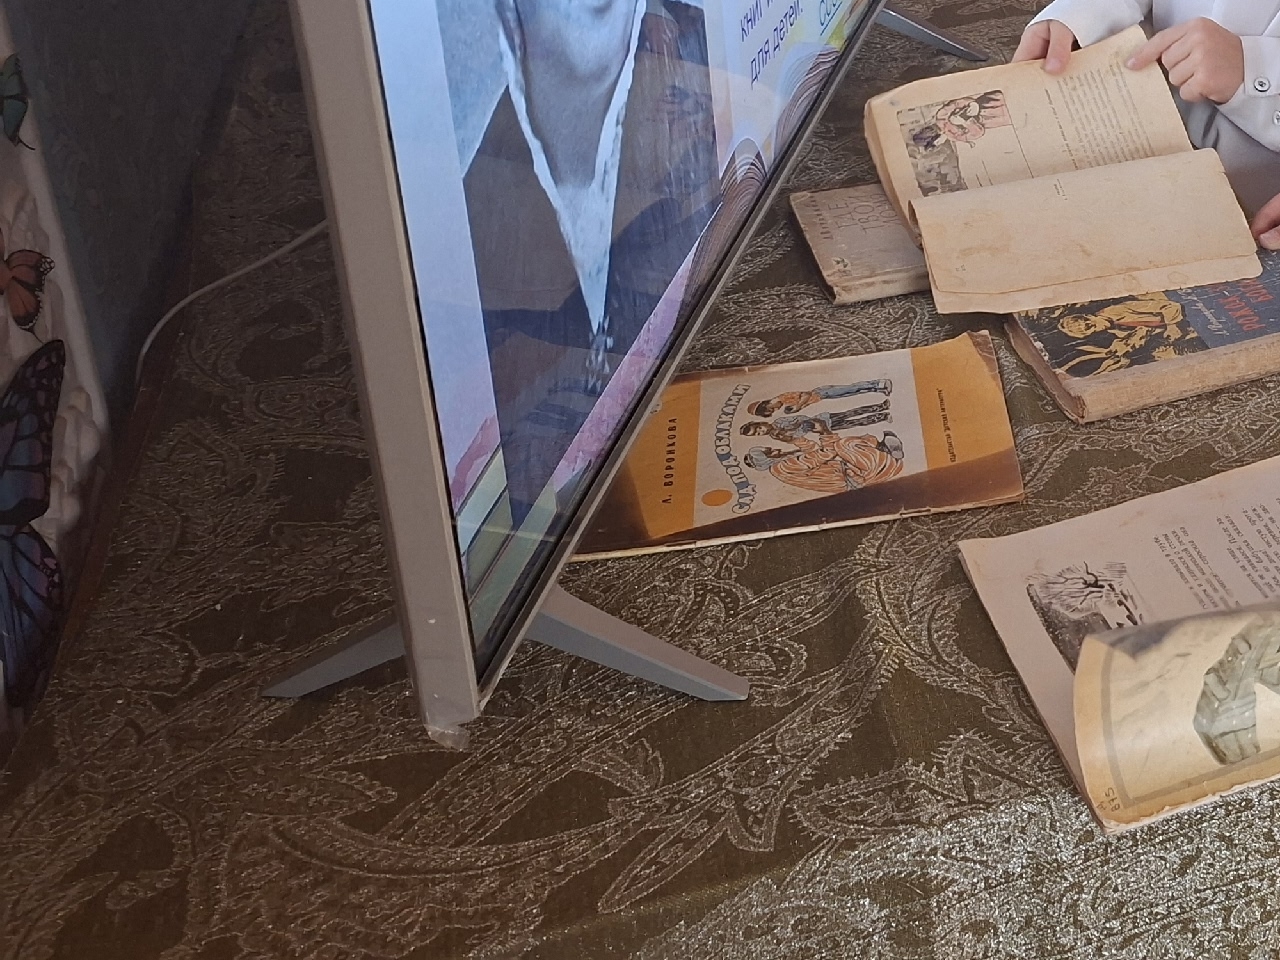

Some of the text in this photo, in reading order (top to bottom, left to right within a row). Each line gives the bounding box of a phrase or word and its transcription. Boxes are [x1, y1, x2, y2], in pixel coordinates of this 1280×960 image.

[750, 42, 770, 84] для
[1222, 296, 1265, 331] РОЖОК
[664, 418, 677, 488] ВОРОНКОВА
[715, 383, 756, 514] САД ПОД ОБЛАКАМИ
[1220, 525, 1237, 545] После
[1241, 538, 1263, 565] бабушка
